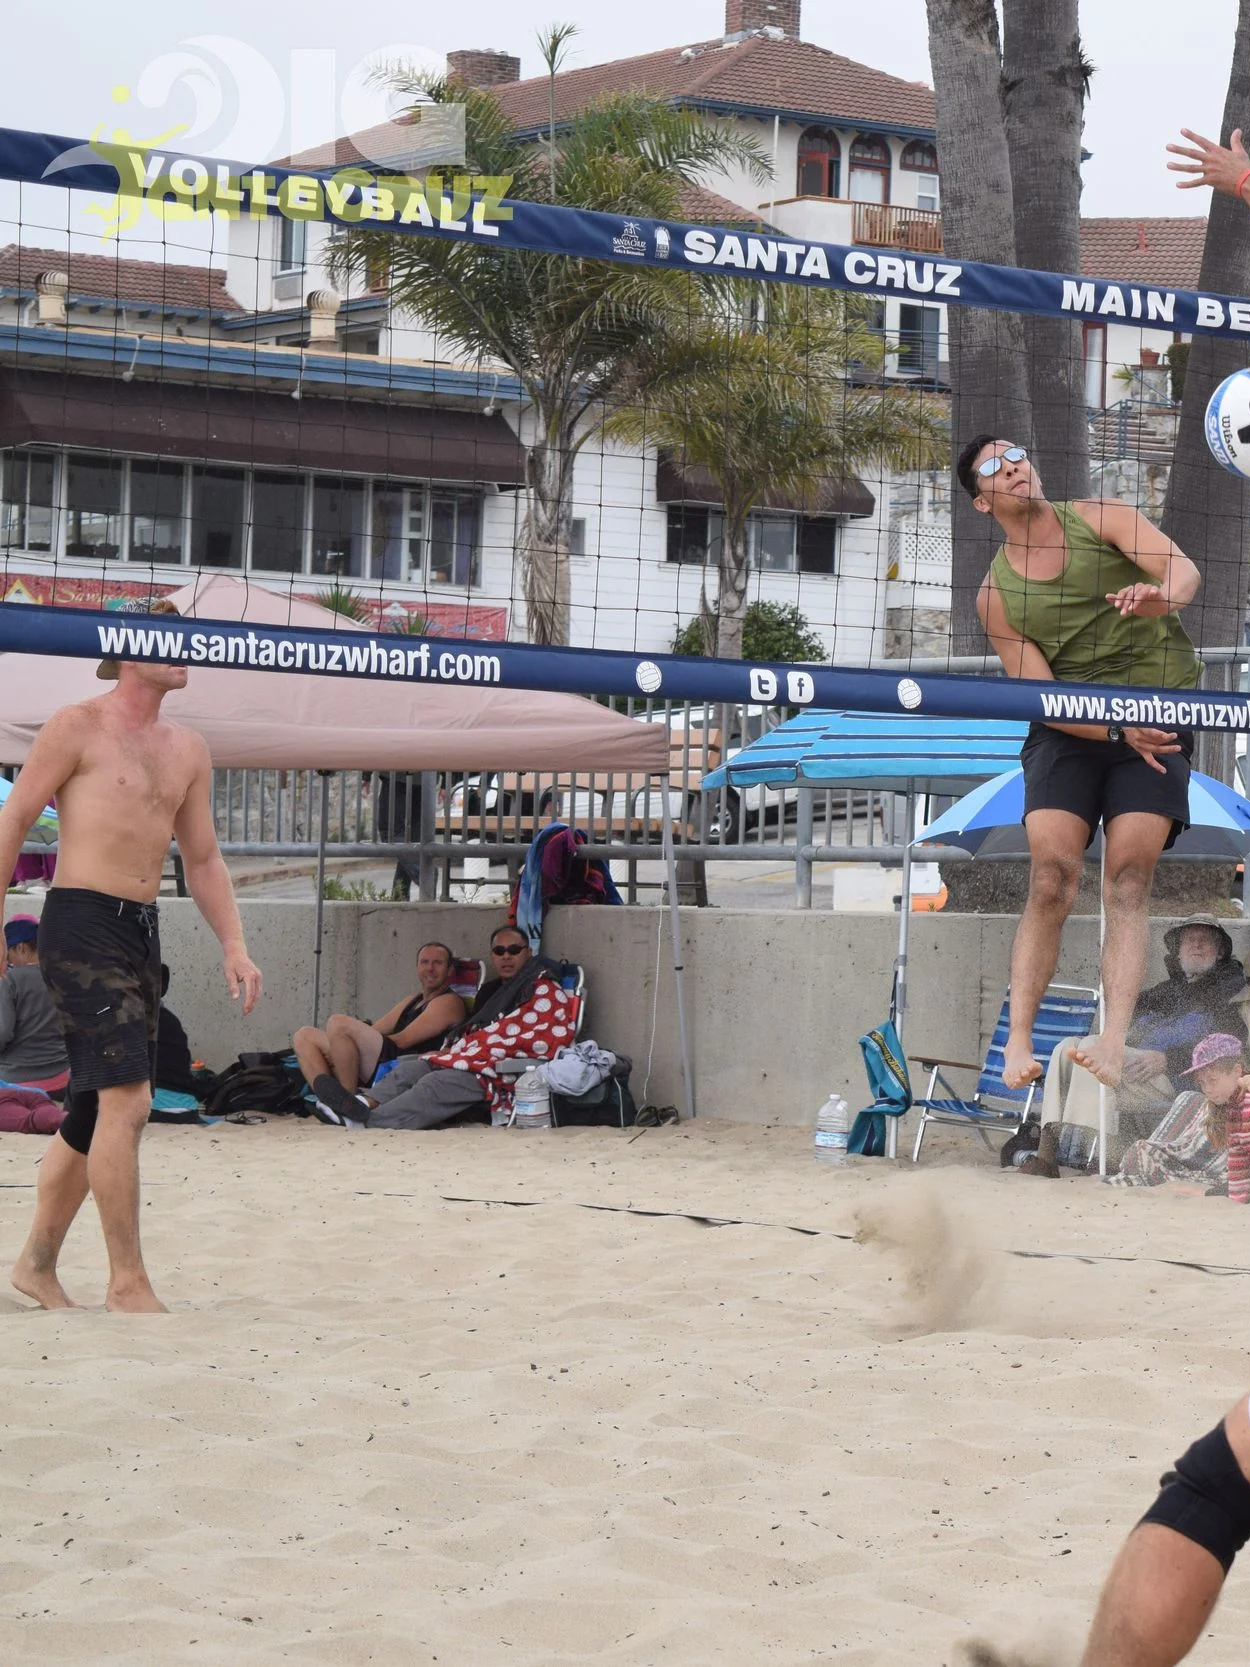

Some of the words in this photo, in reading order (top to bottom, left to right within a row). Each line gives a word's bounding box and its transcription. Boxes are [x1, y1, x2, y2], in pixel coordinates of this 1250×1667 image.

[128, 152, 499, 236] VOLLEYBALL
[684, 230, 830, 279] SANTA
[844, 251, 962, 297] CRUZ
[1061, 280, 1176, 322] MAIN
[98, 625, 501, 682] www.santacruzwharf.com
